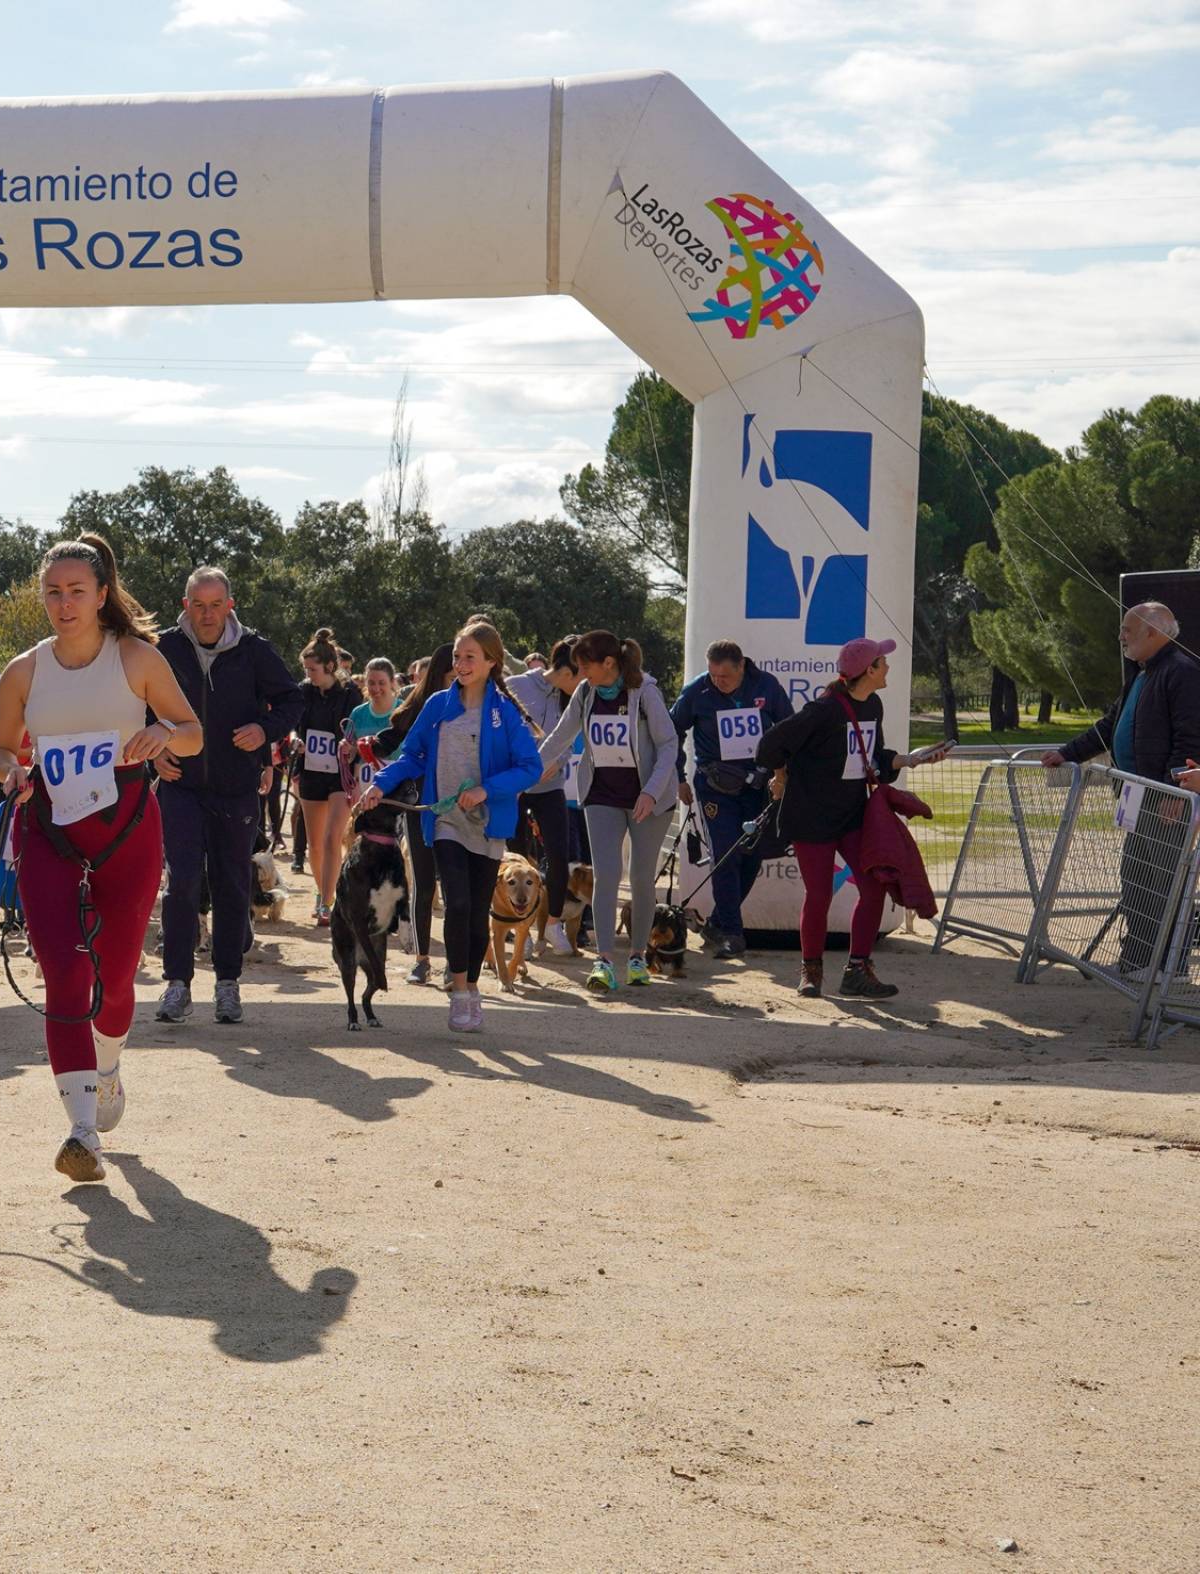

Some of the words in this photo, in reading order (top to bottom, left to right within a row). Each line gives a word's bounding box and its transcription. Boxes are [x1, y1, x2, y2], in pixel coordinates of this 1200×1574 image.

[186, 161, 239, 200] de
[32, 217, 244, 271] Rozas
[614, 203, 705, 291] Deportes
[630, 183, 723, 274] LasRozas
[590, 722, 628, 746] 062
[720, 714, 760, 739] 058
[849, 729, 874, 755] 07
[44, 742, 114, 787] 016
